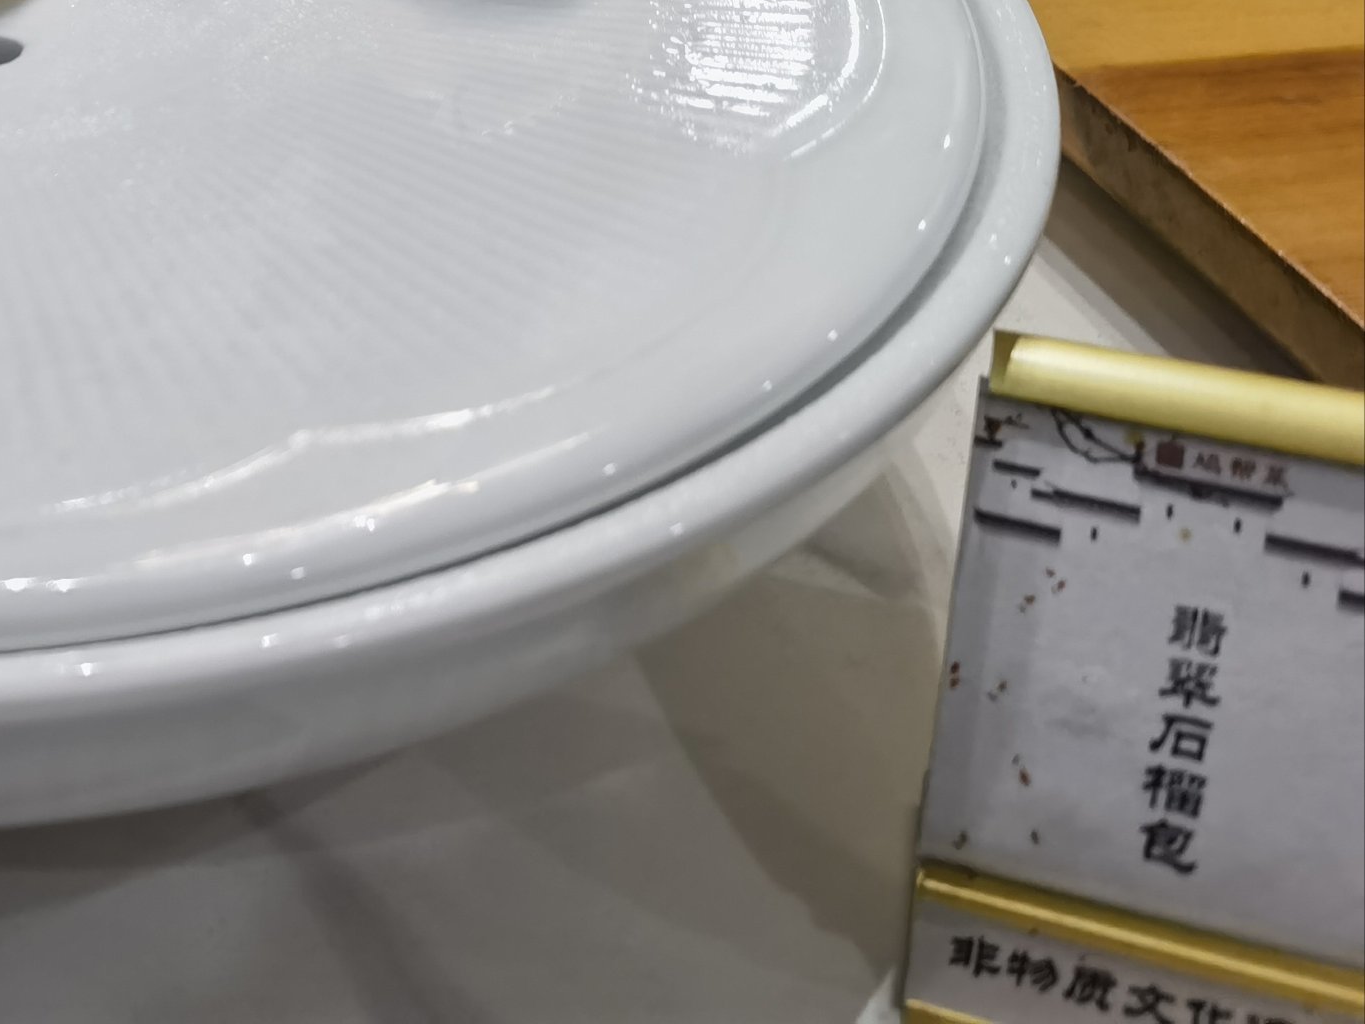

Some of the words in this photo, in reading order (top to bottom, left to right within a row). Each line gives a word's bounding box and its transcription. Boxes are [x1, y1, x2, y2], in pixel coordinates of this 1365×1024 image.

[1138, 603, 1228, 875] 翡翠石榴包
[948, 935, 1297, 1024] 非物质文化
